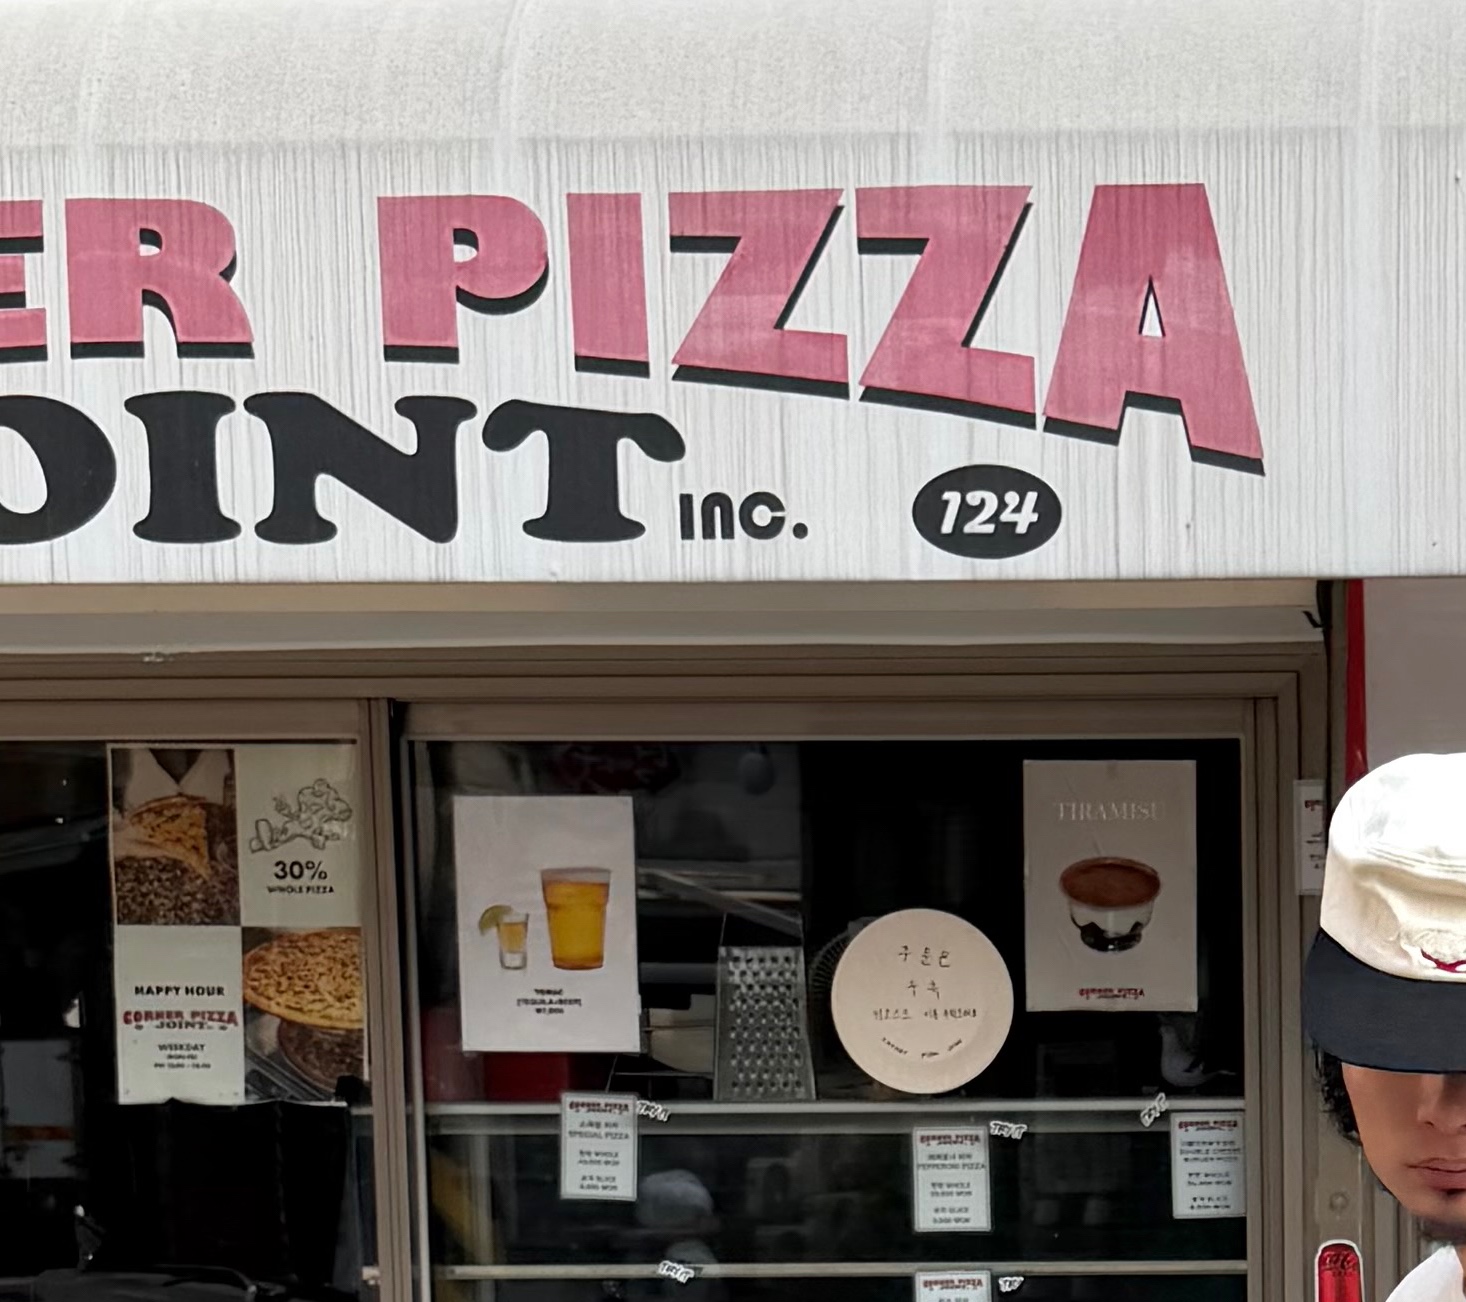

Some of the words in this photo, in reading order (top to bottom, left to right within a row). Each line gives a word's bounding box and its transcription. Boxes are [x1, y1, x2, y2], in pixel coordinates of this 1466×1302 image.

[377, 183, 1265, 476] PIZZA
[0, 391, 686, 545] OINT
[940, 489, 1040, 536] 124
[1054, 802, 1164, 820] TIRAMISU
[274, 860, 328, 880] 30%
[134, 985, 181, 996] HAPPY
[185, 985, 226, 997] HOUR
[190, 1010, 239, 1027] PIZZA
